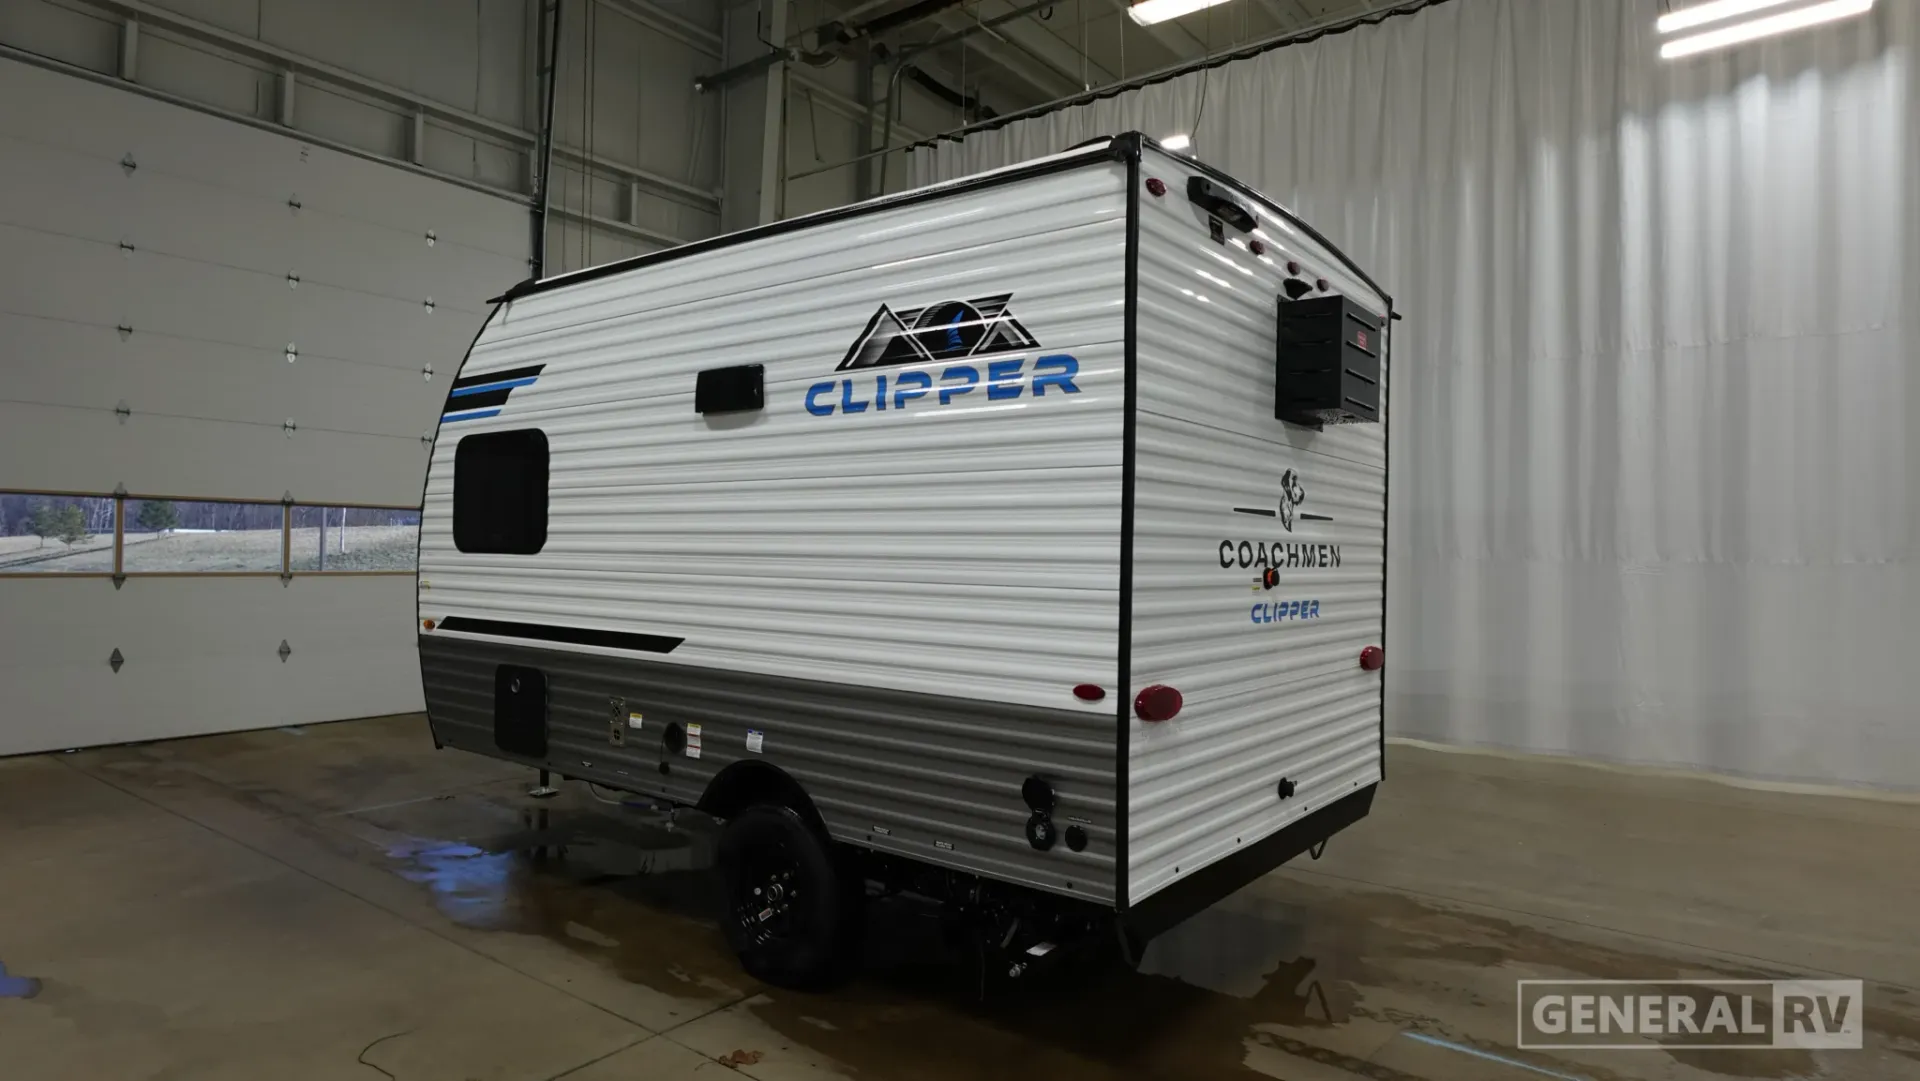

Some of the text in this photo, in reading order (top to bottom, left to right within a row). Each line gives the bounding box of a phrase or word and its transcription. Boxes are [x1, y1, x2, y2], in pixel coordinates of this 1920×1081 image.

[804, 354, 1081, 416] CLIPPER
[1219, 539, 1341, 569] COACHMEN
[1251, 600, 1320, 623] CLIPPER
